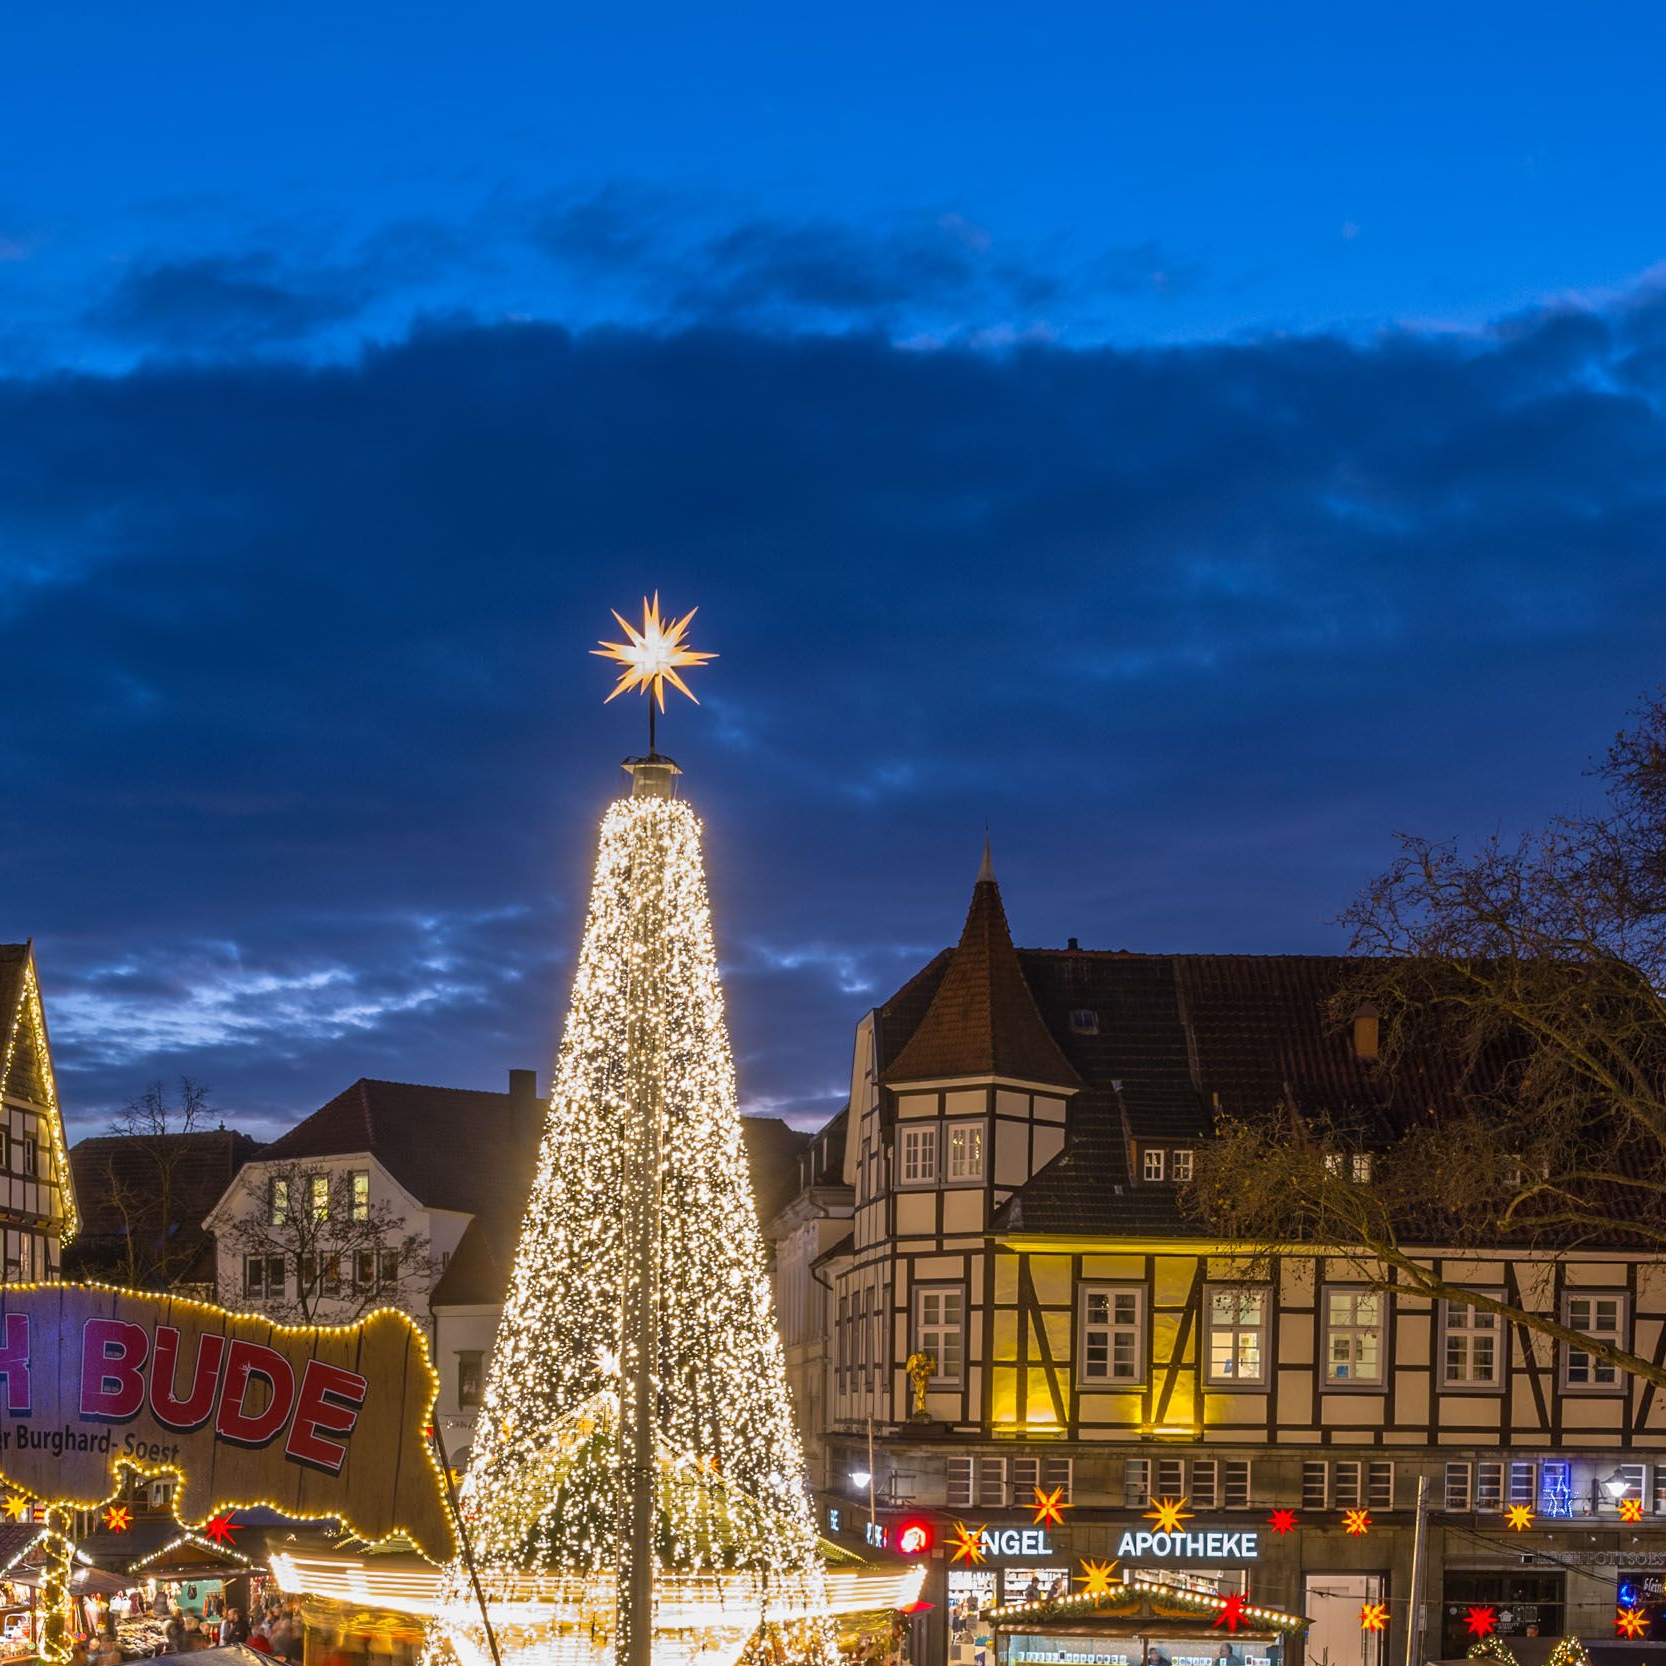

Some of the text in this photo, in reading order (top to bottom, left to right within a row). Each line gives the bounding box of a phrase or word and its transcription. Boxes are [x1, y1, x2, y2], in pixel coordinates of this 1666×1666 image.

[78, 1316, 369, 1475] BUDE
[15, 1423, 119, 1458] Burghard-
[123, 1432, 181, 1465] Soest
[965, 1530, 1258, 1558] NGEL APOTHEKE
